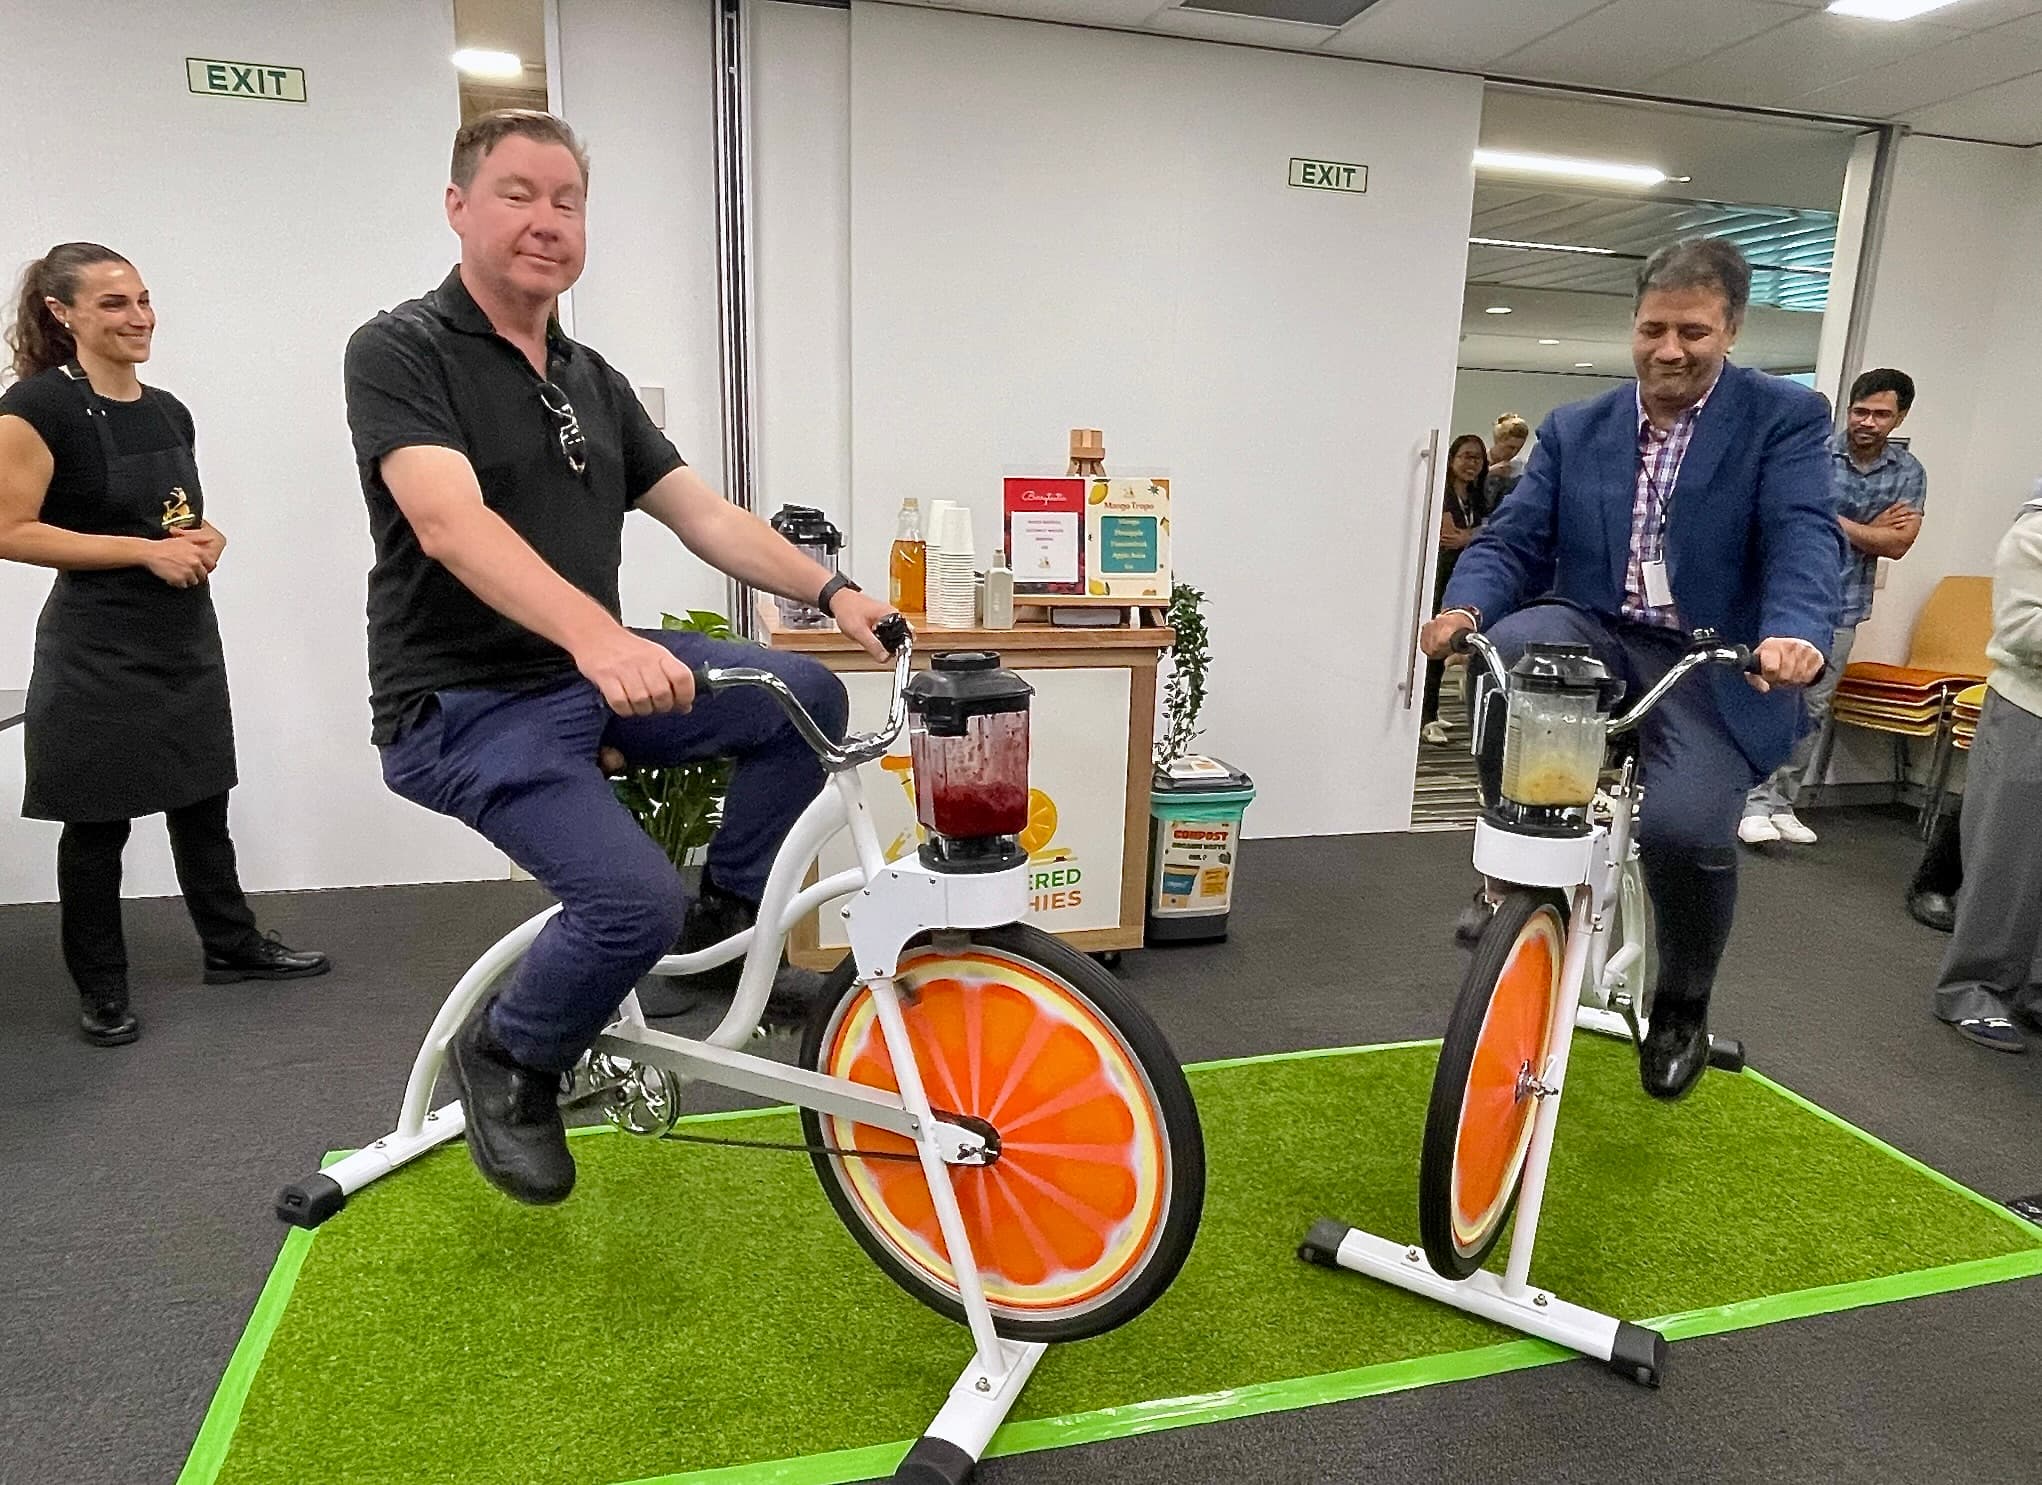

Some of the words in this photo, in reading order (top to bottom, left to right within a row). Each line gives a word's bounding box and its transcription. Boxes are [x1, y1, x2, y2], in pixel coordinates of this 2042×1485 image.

[207, 64, 286, 96] EXIT
[1301, 163, 1356, 188] EXIT
[1104, 502, 1130, 512] Mango
[1173, 830, 1229, 841] COMPOST
